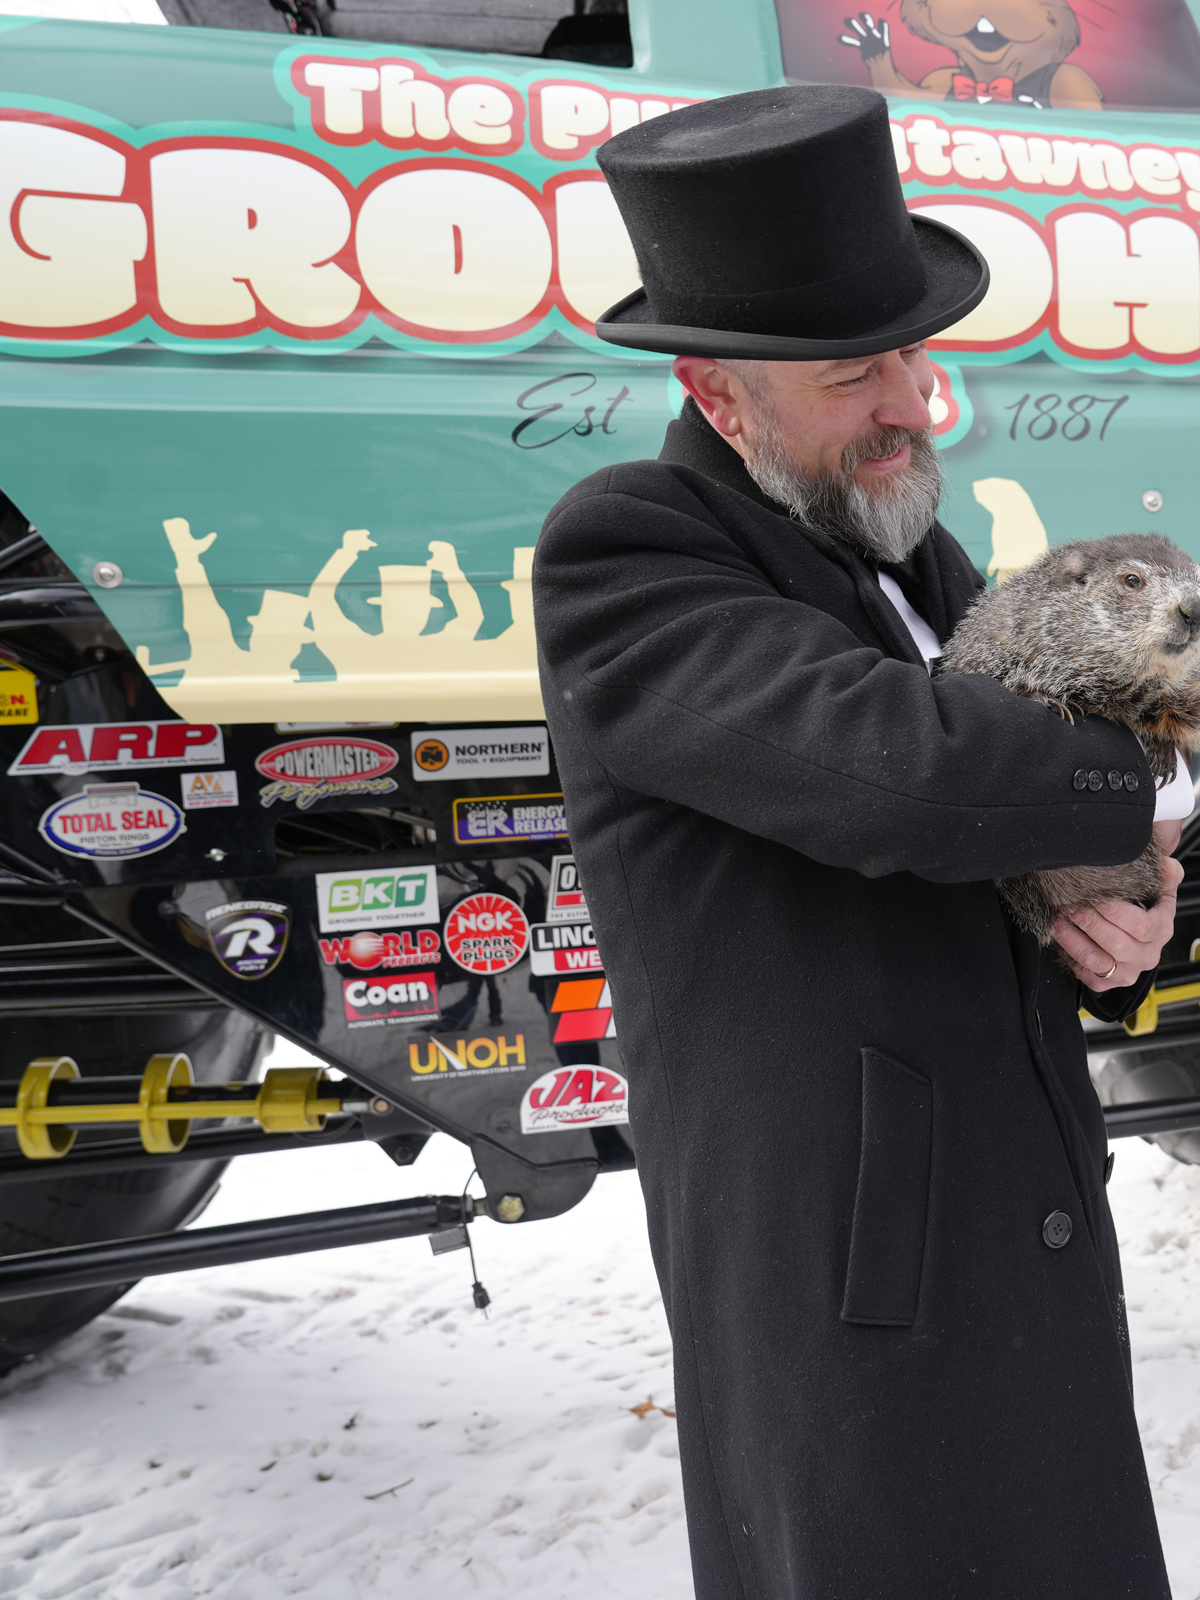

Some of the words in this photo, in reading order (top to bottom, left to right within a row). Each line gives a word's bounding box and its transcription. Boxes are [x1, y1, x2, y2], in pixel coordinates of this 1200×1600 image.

[303, 60, 515, 146] The
[511, 372, 630, 450] Est
[1004, 393, 1130, 442] 1887
[18, 724, 218, 765] ARP
[455, 742, 542, 756] NORTHERN
[274, 745, 381, 778] POWERMASTER
[456, 757, 479, 765] TOOL
[490, 755, 542, 763] EQUIPMENT
[262, 778, 395, 807] Performance
[59, 812, 117, 834] TOTAL
[122, 810, 168, 831] SEAL
[513, 805, 564, 820] ENERGY
[79, 835, 117, 844] PISTON
[120, 833, 150, 841] RINGS
[330, 877, 426, 910] BKT
[328, 916, 373, 925] GROWING
[375, 911, 426, 920] TOGETHER
[457, 910, 513, 934] NGK
[319, 929, 441, 970] WORLD
[462, 936, 514, 949] SPARK
[382, 953, 441, 968] PRODUCTS
[462, 949, 515, 962] PLUGS
[345, 980, 430, 1008] Coan
[348, 1018, 385, 1029] AUTOMATIC
[387, 1014, 440, 1025] TRANSMISSIONS
[409, 1034, 526, 1075] UNOH
[411, 1072, 449, 1082] UNIVERSITY
[458, 1066, 510, 1078] NORTHWESTERN
[529, 1069, 626, 1109] JAZ
